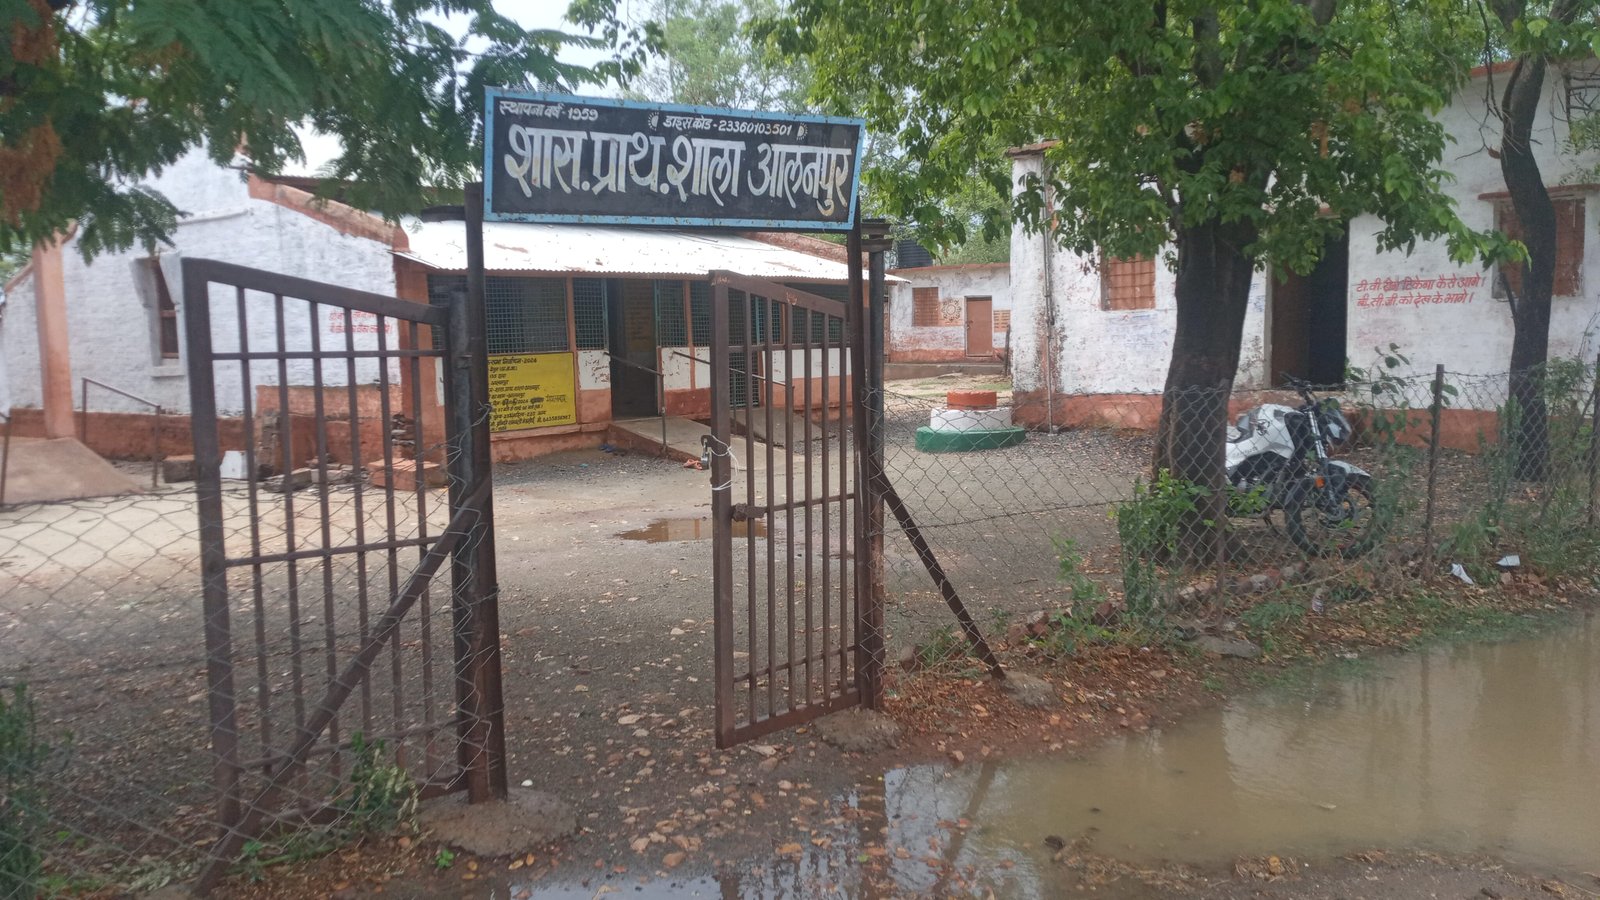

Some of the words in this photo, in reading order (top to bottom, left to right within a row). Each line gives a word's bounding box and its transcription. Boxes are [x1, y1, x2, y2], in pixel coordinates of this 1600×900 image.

[499, 101, 545, 117] स्थापना
[544, 103, 562, 119] वर्ष
[568, 107, 599, 121] 1959
[692, 114, 713, 130] कोड
[718, 119, 793, 136] 23360103501
[748, 142, 852, 217] आलनपुर
[1431, 290, 1444, 305] के
